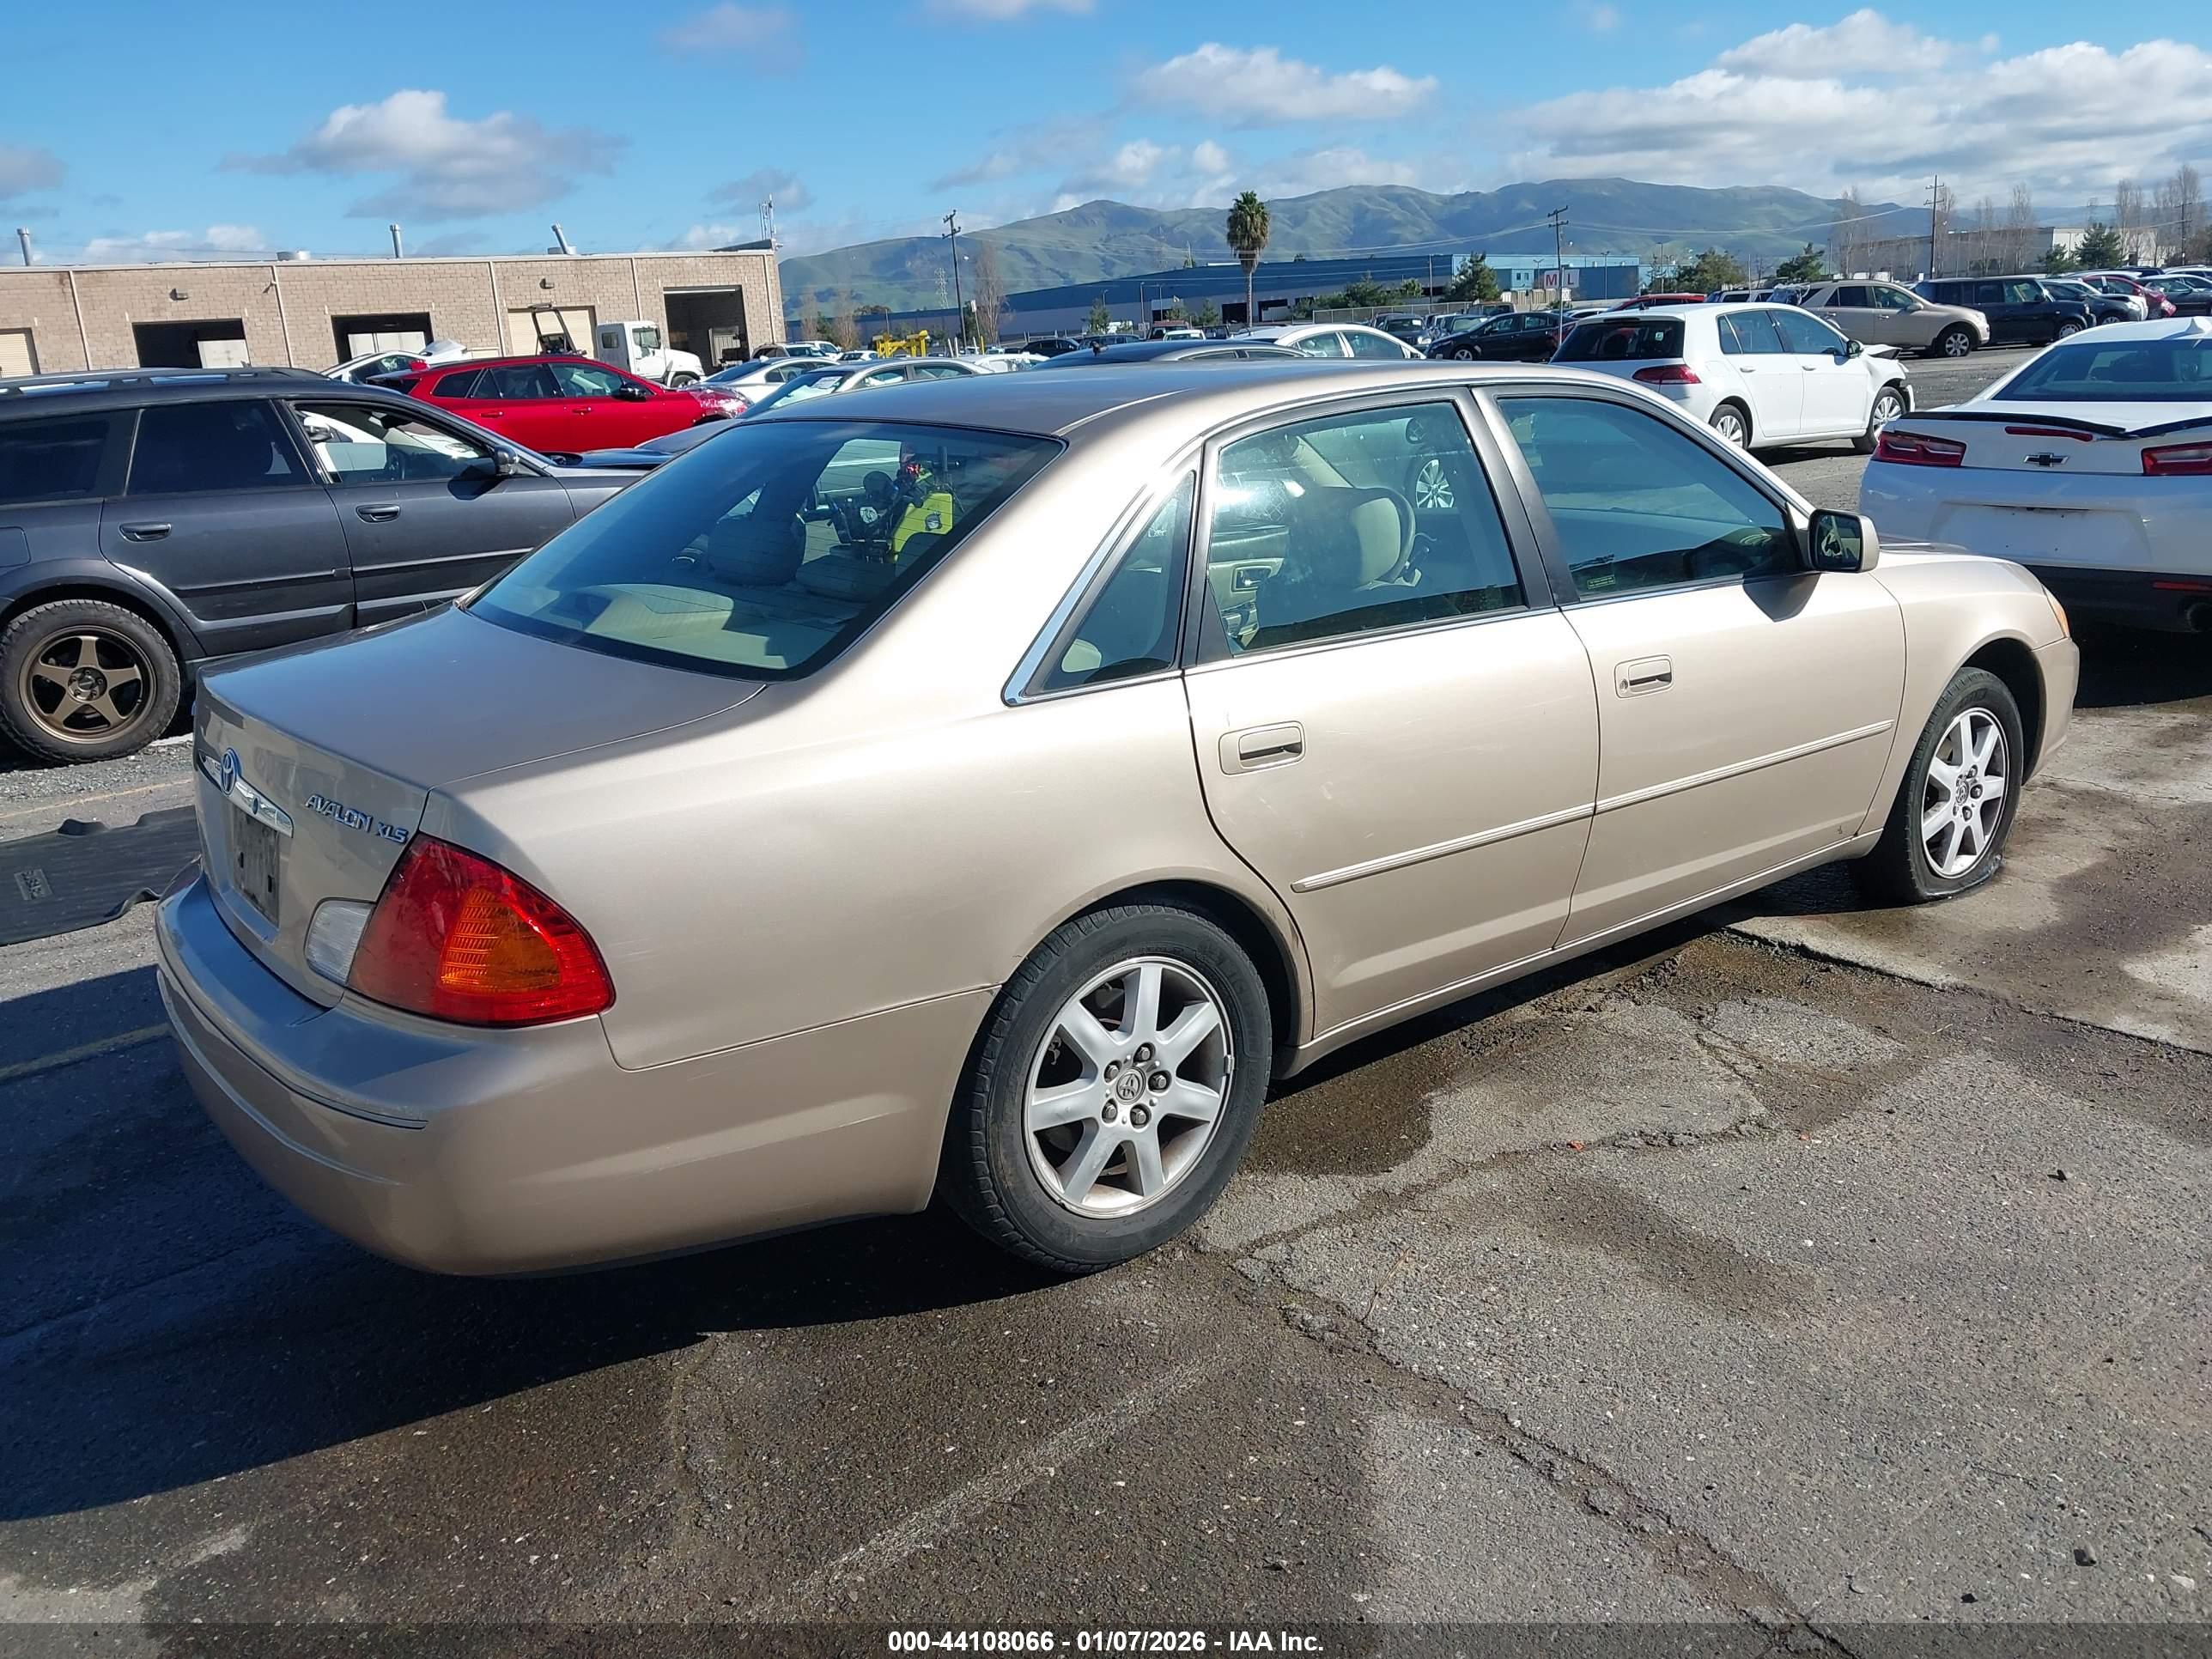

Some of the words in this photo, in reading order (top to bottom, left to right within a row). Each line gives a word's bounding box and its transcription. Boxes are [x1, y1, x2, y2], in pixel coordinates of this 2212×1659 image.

[1546, 273, 1558, 286] M
[1567, 273, 1575, 285] L
[305, 793, 374, 833] AVALON
[376, 821, 410, 845] XLS
